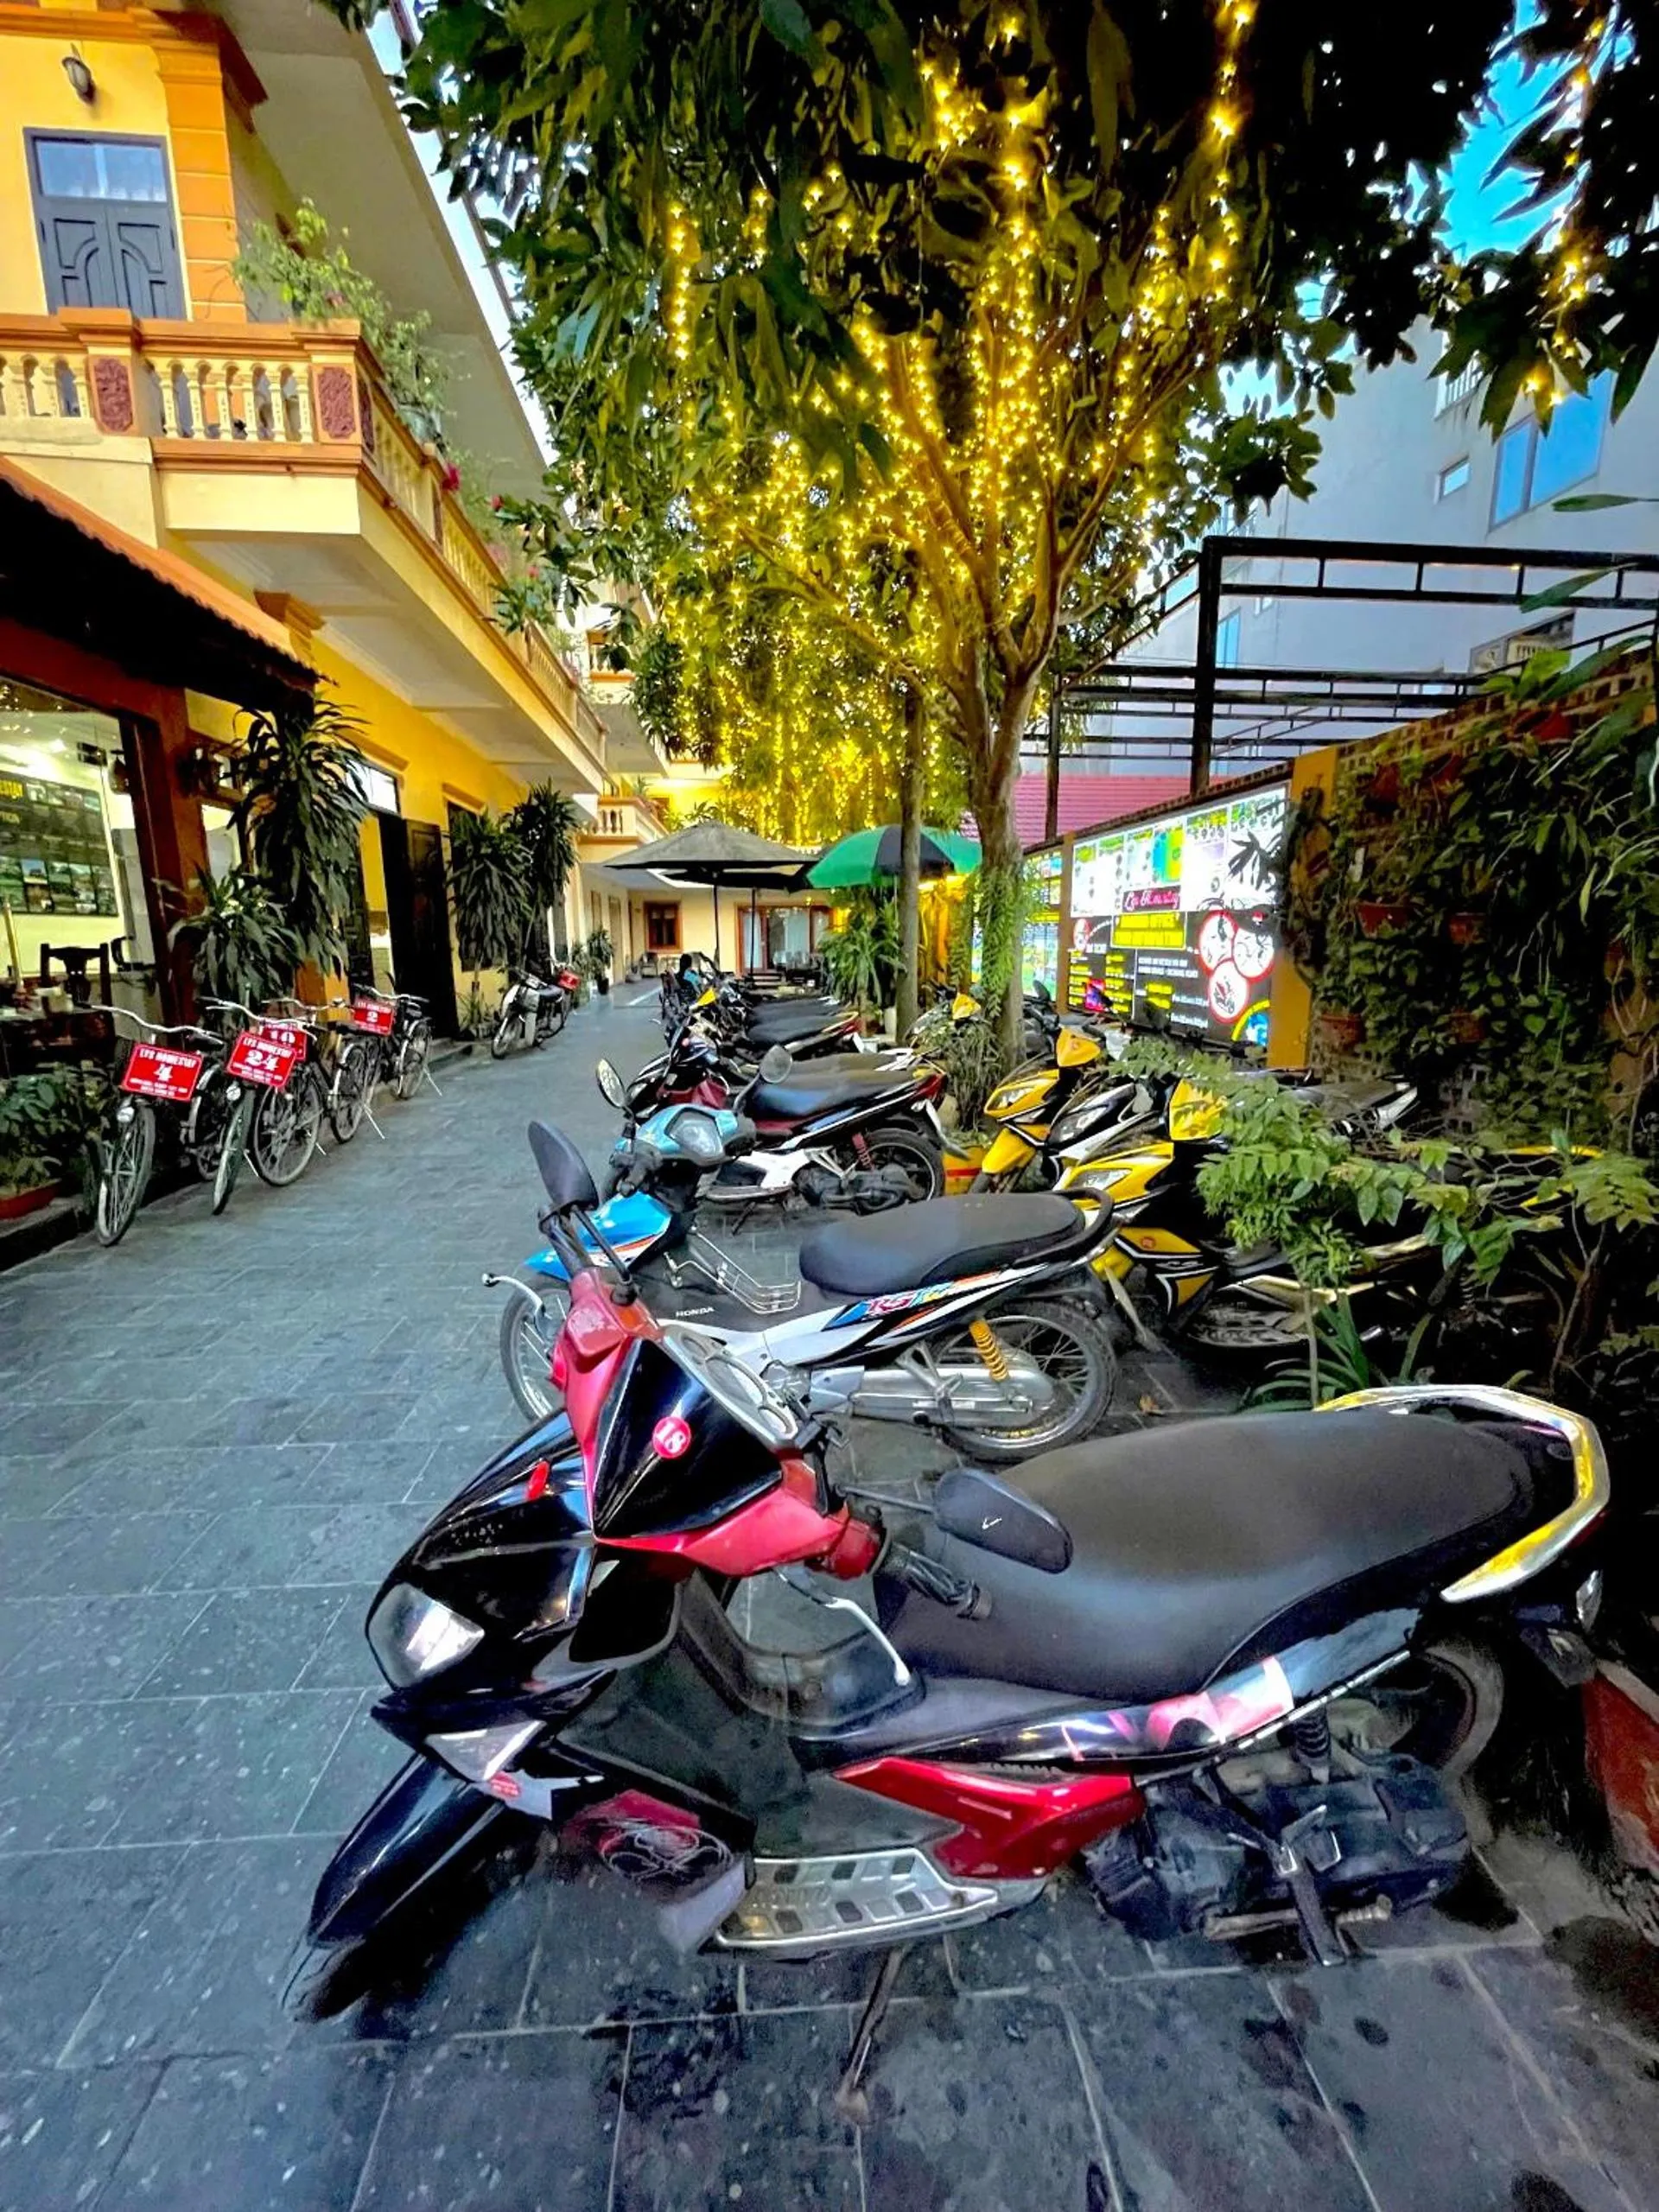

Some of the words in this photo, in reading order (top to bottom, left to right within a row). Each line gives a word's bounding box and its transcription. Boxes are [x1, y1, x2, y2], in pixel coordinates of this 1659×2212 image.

[245, 1049, 279, 1071] 24
[153, 1063, 173, 1083] 4
[675, 1306, 715, 1318] HONDA
[656, 1421, 686, 1453] 18
